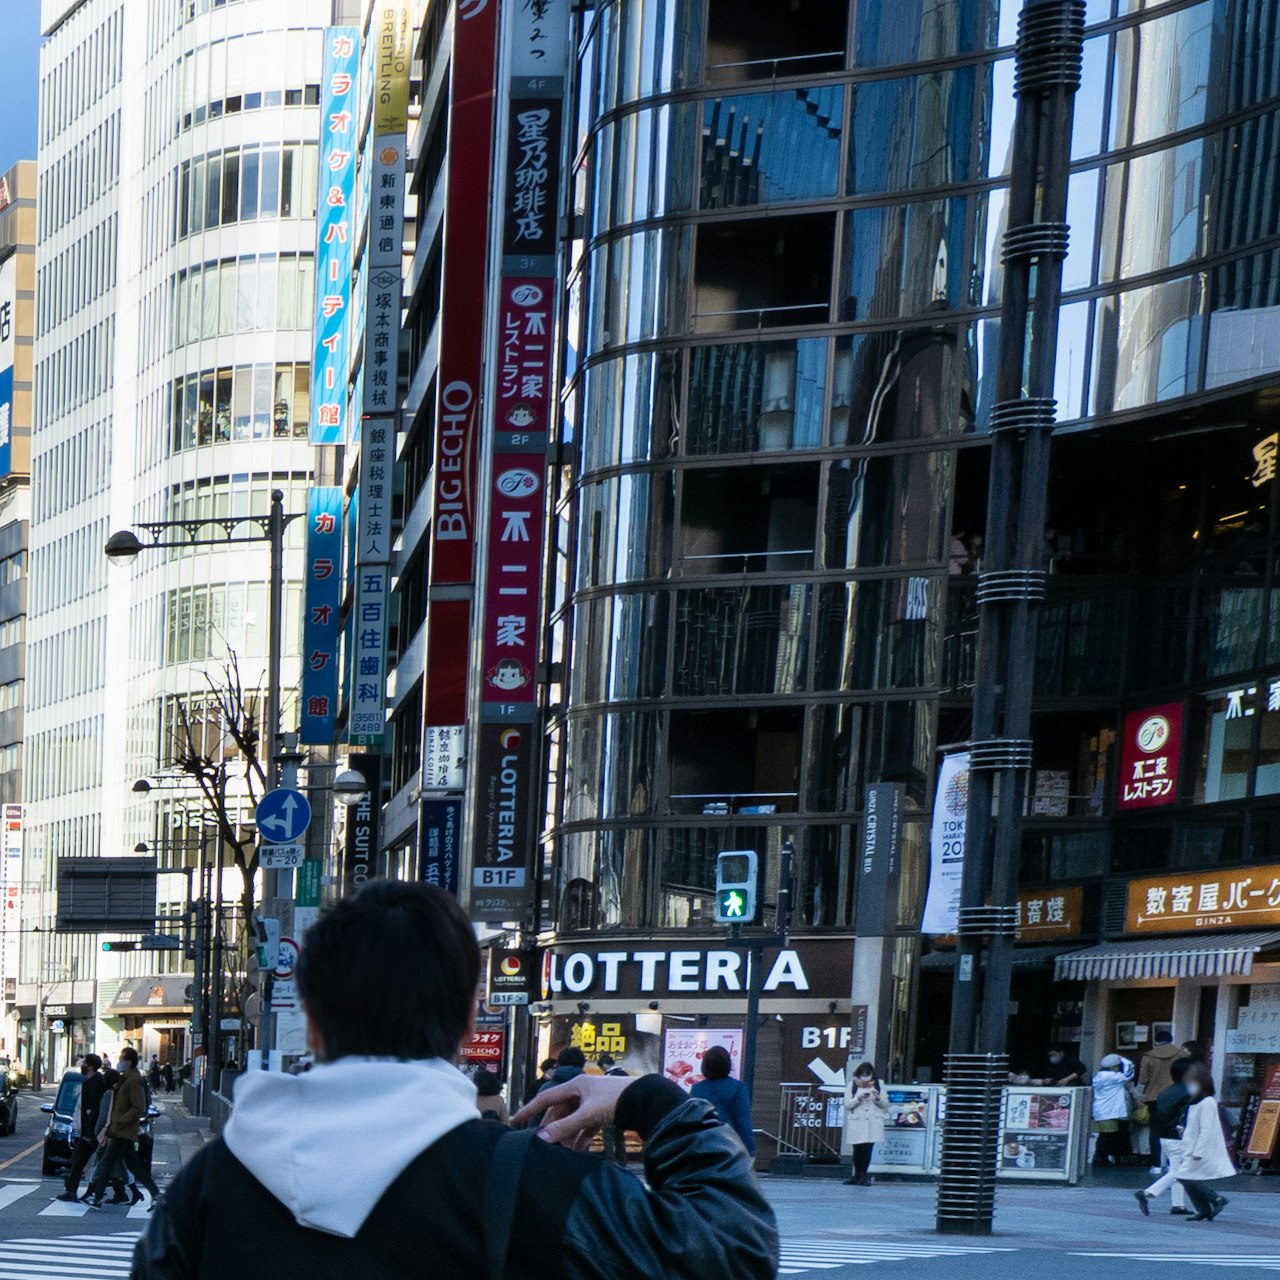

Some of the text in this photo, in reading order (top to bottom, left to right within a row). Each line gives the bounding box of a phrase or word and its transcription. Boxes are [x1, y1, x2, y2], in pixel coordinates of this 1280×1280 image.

[380, 10, 394, 104] BREITLING
[527, 79, 546, 90] 4F
[512, 107, 551, 246] 星乃珈琲店
[378, 173, 397, 253] 新東通信
[519, 258, 537, 269] 3F
[371, 293, 392, 407] 塚本商事機械
[502, 312, 521, 398] レストラン
[521, 312, 546, 399] 不二家
[511, 434, 529, 446] 2F
[496, 511, 531, 647] 不二家
[307, 513, 335, 717] カラオケ館
[358, 574, 383, 703] 五百住歯科
[498, 704, 515, 715] 1F
[1132, 757, 1168, 780] 不二家
[356, 790, 372, 822] THE
[1123, 778, 1174, 802] レストラン
[497, 755, 518, 863] LOTTERIA
[354, 825, 370, 861] SUIT
[482, 869, 517, 885] B1F
[1195, 916, 1232, 926] GINZA
[493, 994, 513, 1003] B1F
[571, 1021, 626, 1052] 絶品
